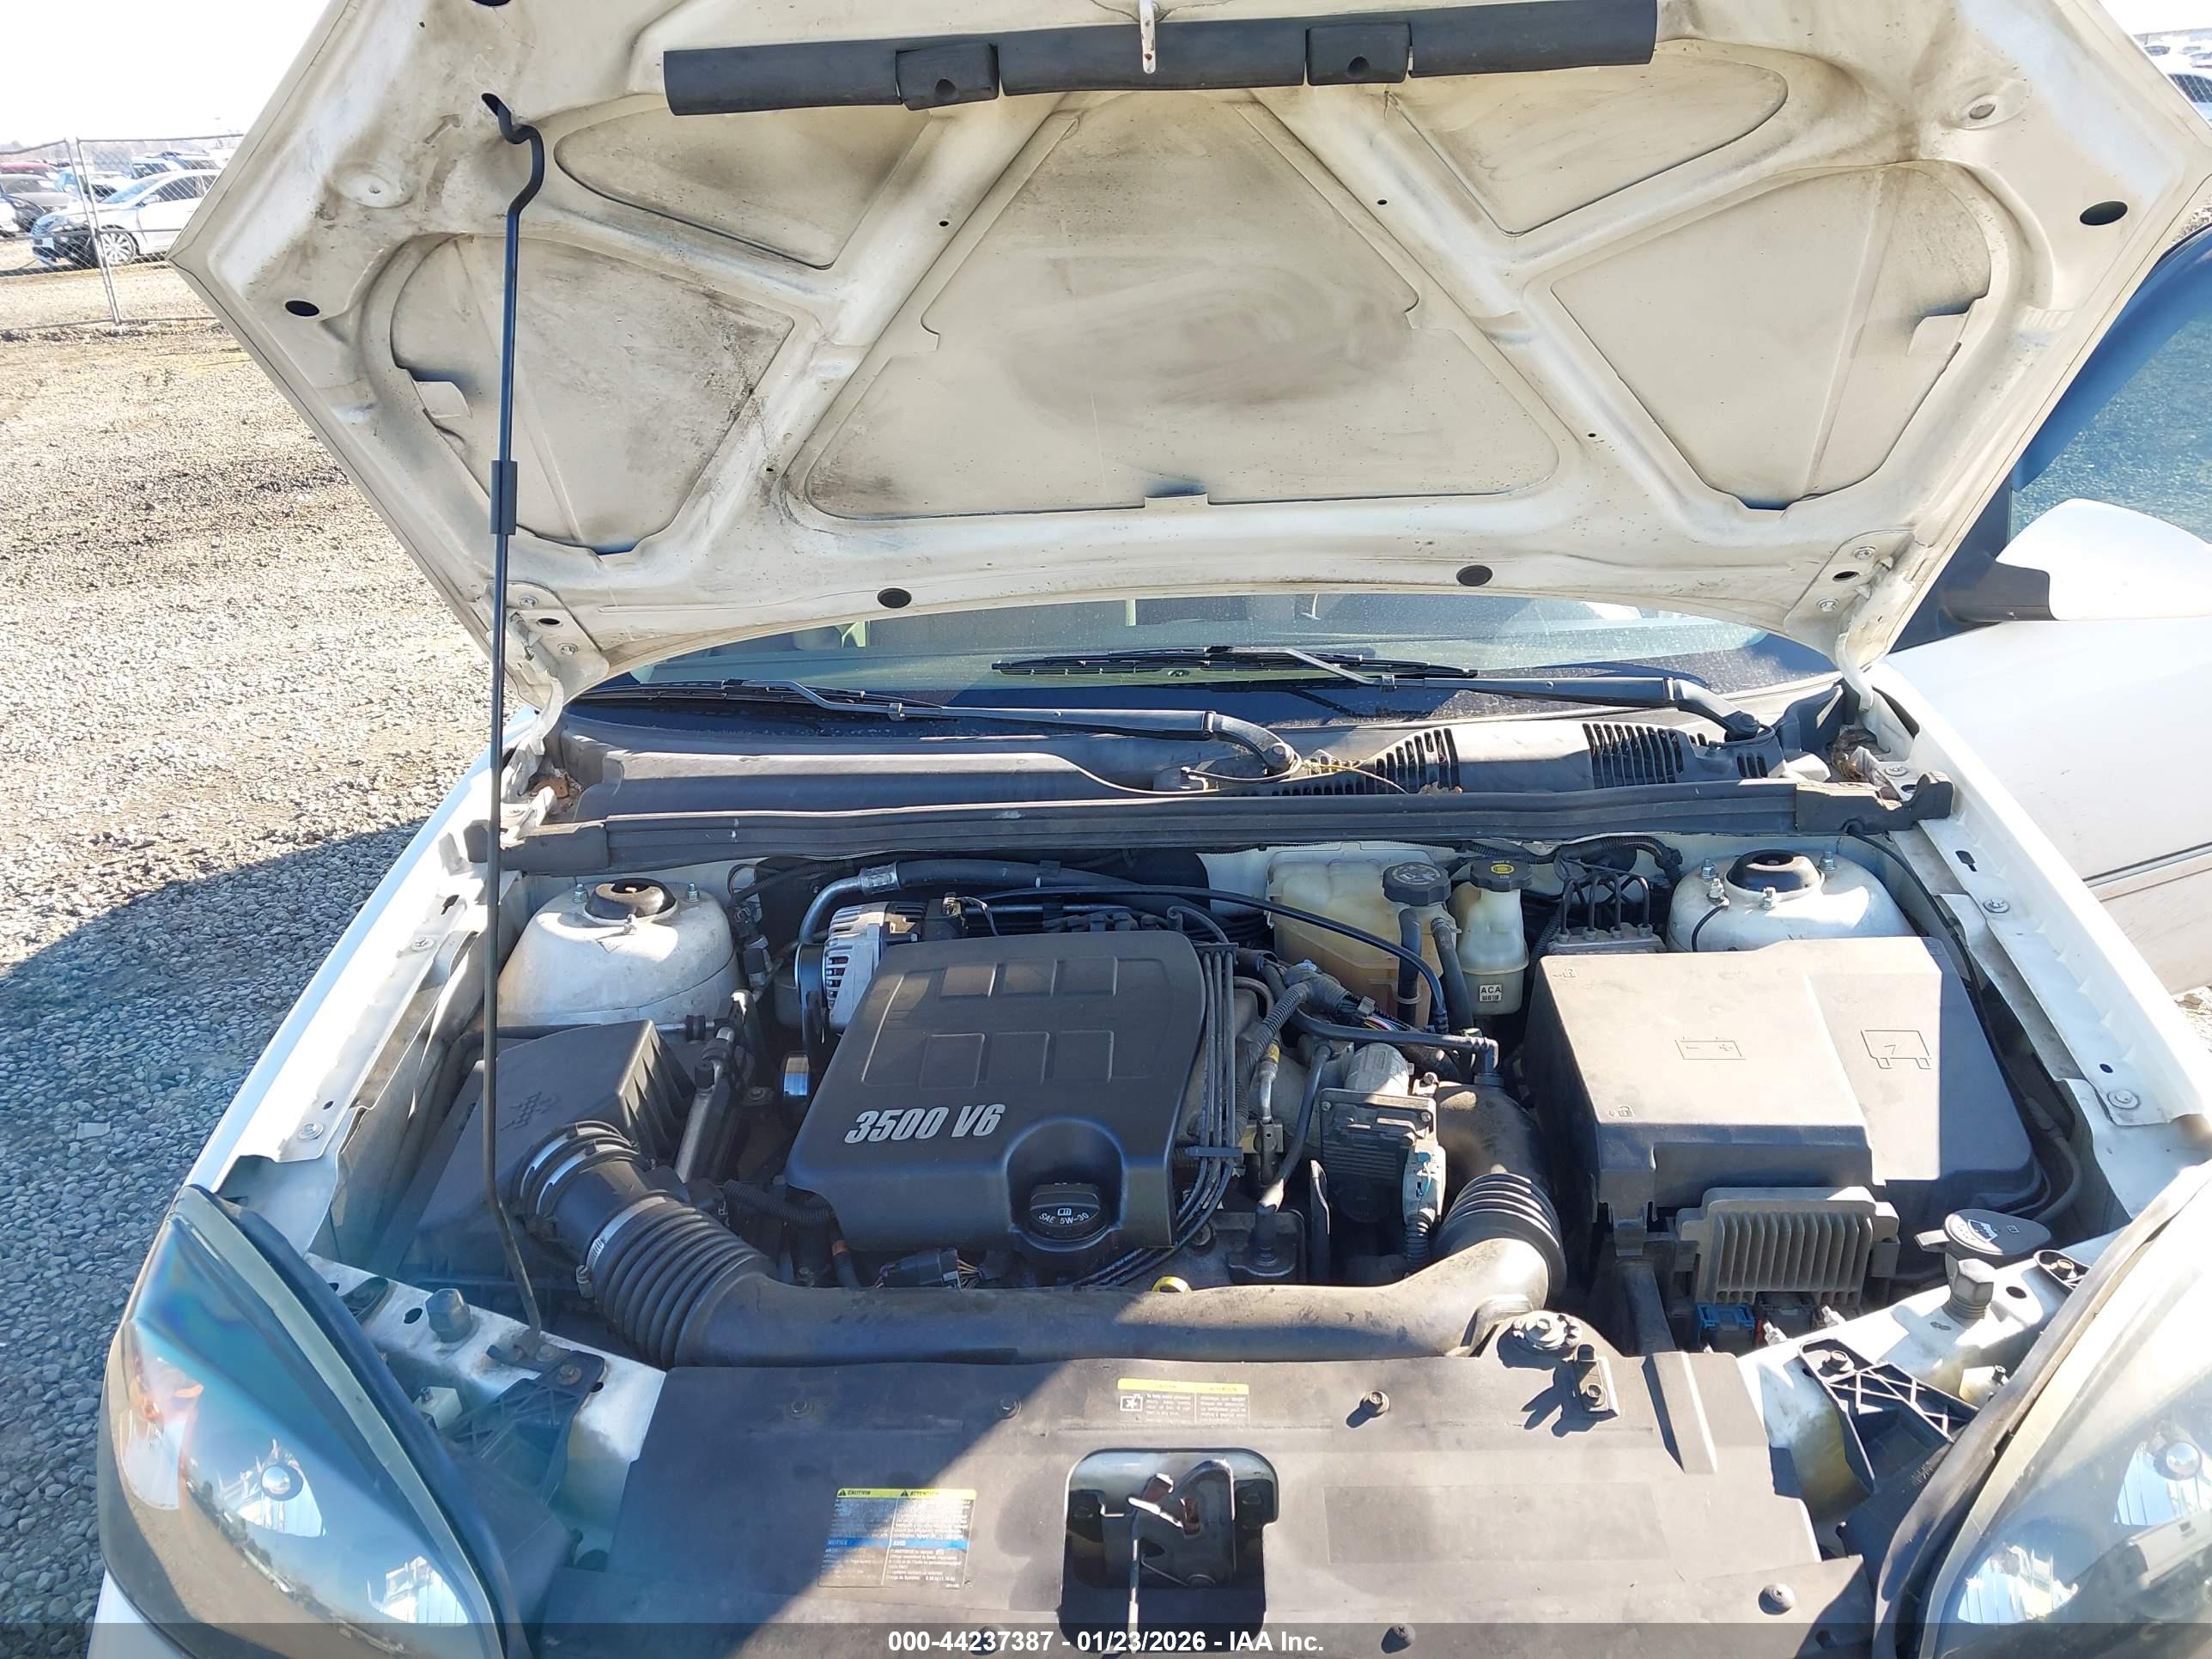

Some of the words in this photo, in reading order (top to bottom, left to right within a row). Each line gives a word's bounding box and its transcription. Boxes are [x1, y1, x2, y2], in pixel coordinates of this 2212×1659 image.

[1481, 986, 1501, 994] ACA
[844, 1107, 950, 1144] 3500
[951, 1103, 1006, 1138] V6
[1038, 1212, 1056, 1224] SAE
[1059, 1212, 1090, 1224] 5W-30
